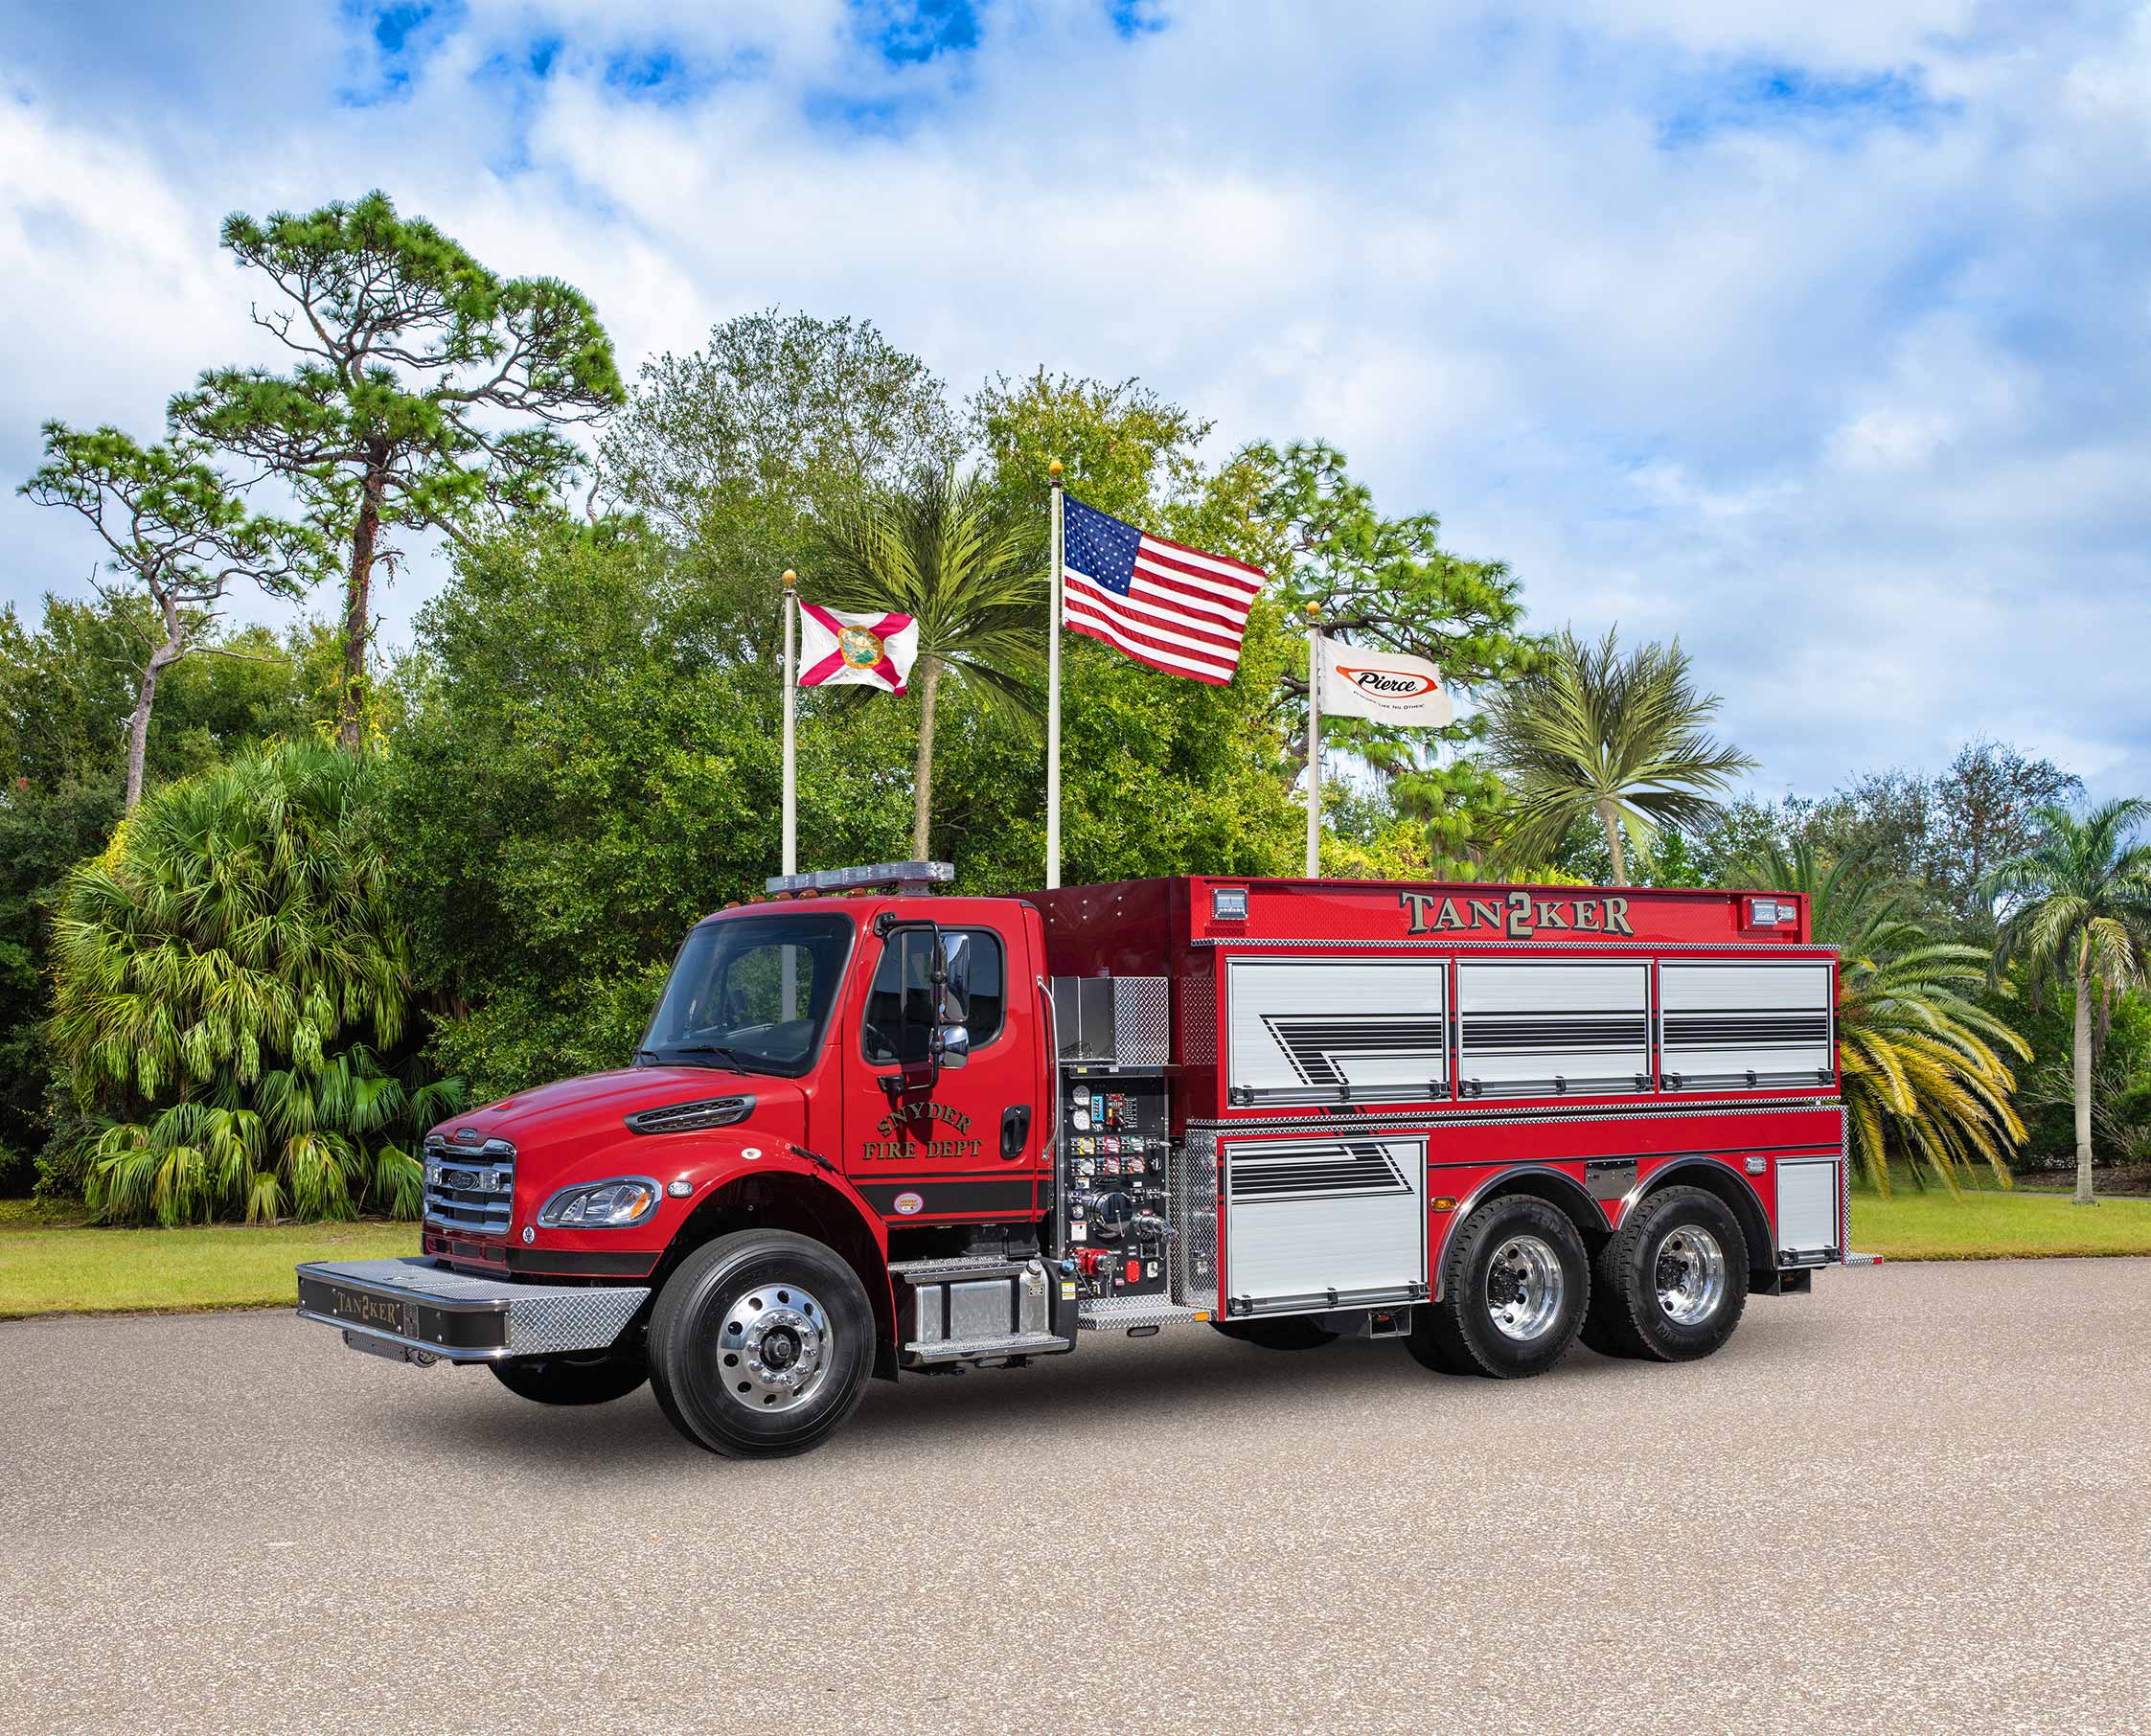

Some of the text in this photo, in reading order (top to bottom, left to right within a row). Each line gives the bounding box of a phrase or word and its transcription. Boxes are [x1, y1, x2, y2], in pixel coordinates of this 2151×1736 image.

[1358, 672, 1416, 692] Pierce
[877, 1102, 973, 1138] SNYDER
[863, 1139, 982, 1160] FIRE DEPT
